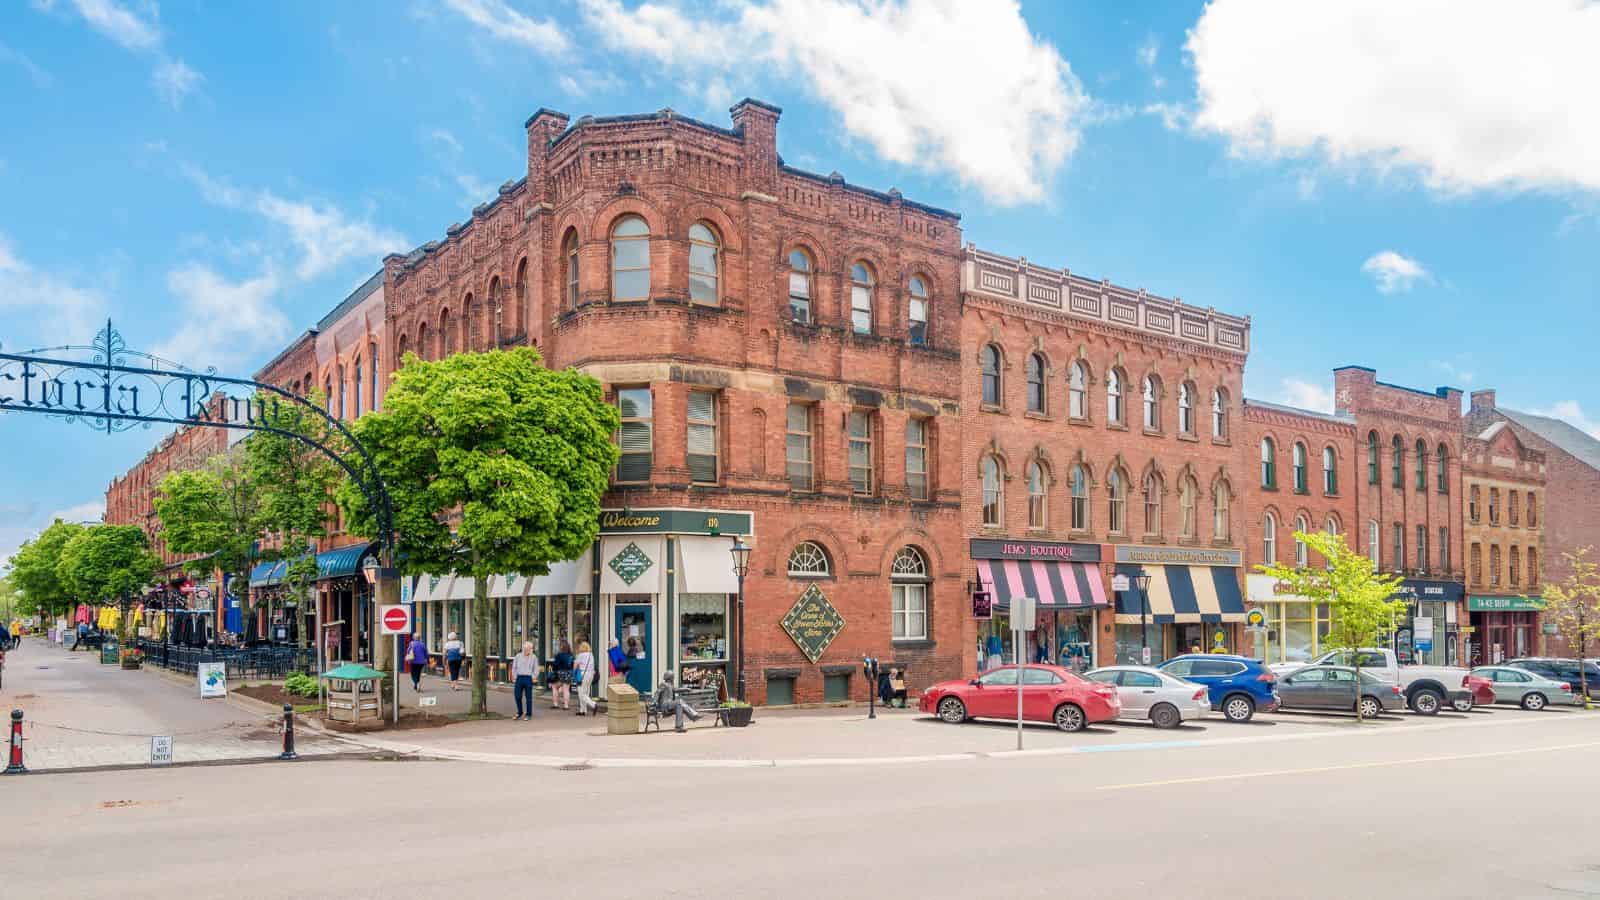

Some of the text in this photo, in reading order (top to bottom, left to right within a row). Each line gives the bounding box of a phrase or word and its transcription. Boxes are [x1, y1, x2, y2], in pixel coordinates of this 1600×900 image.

[603, 512, 660, 528] Welcome
[1002, 543, 1073, 558] JEMS BOUTIQUE
